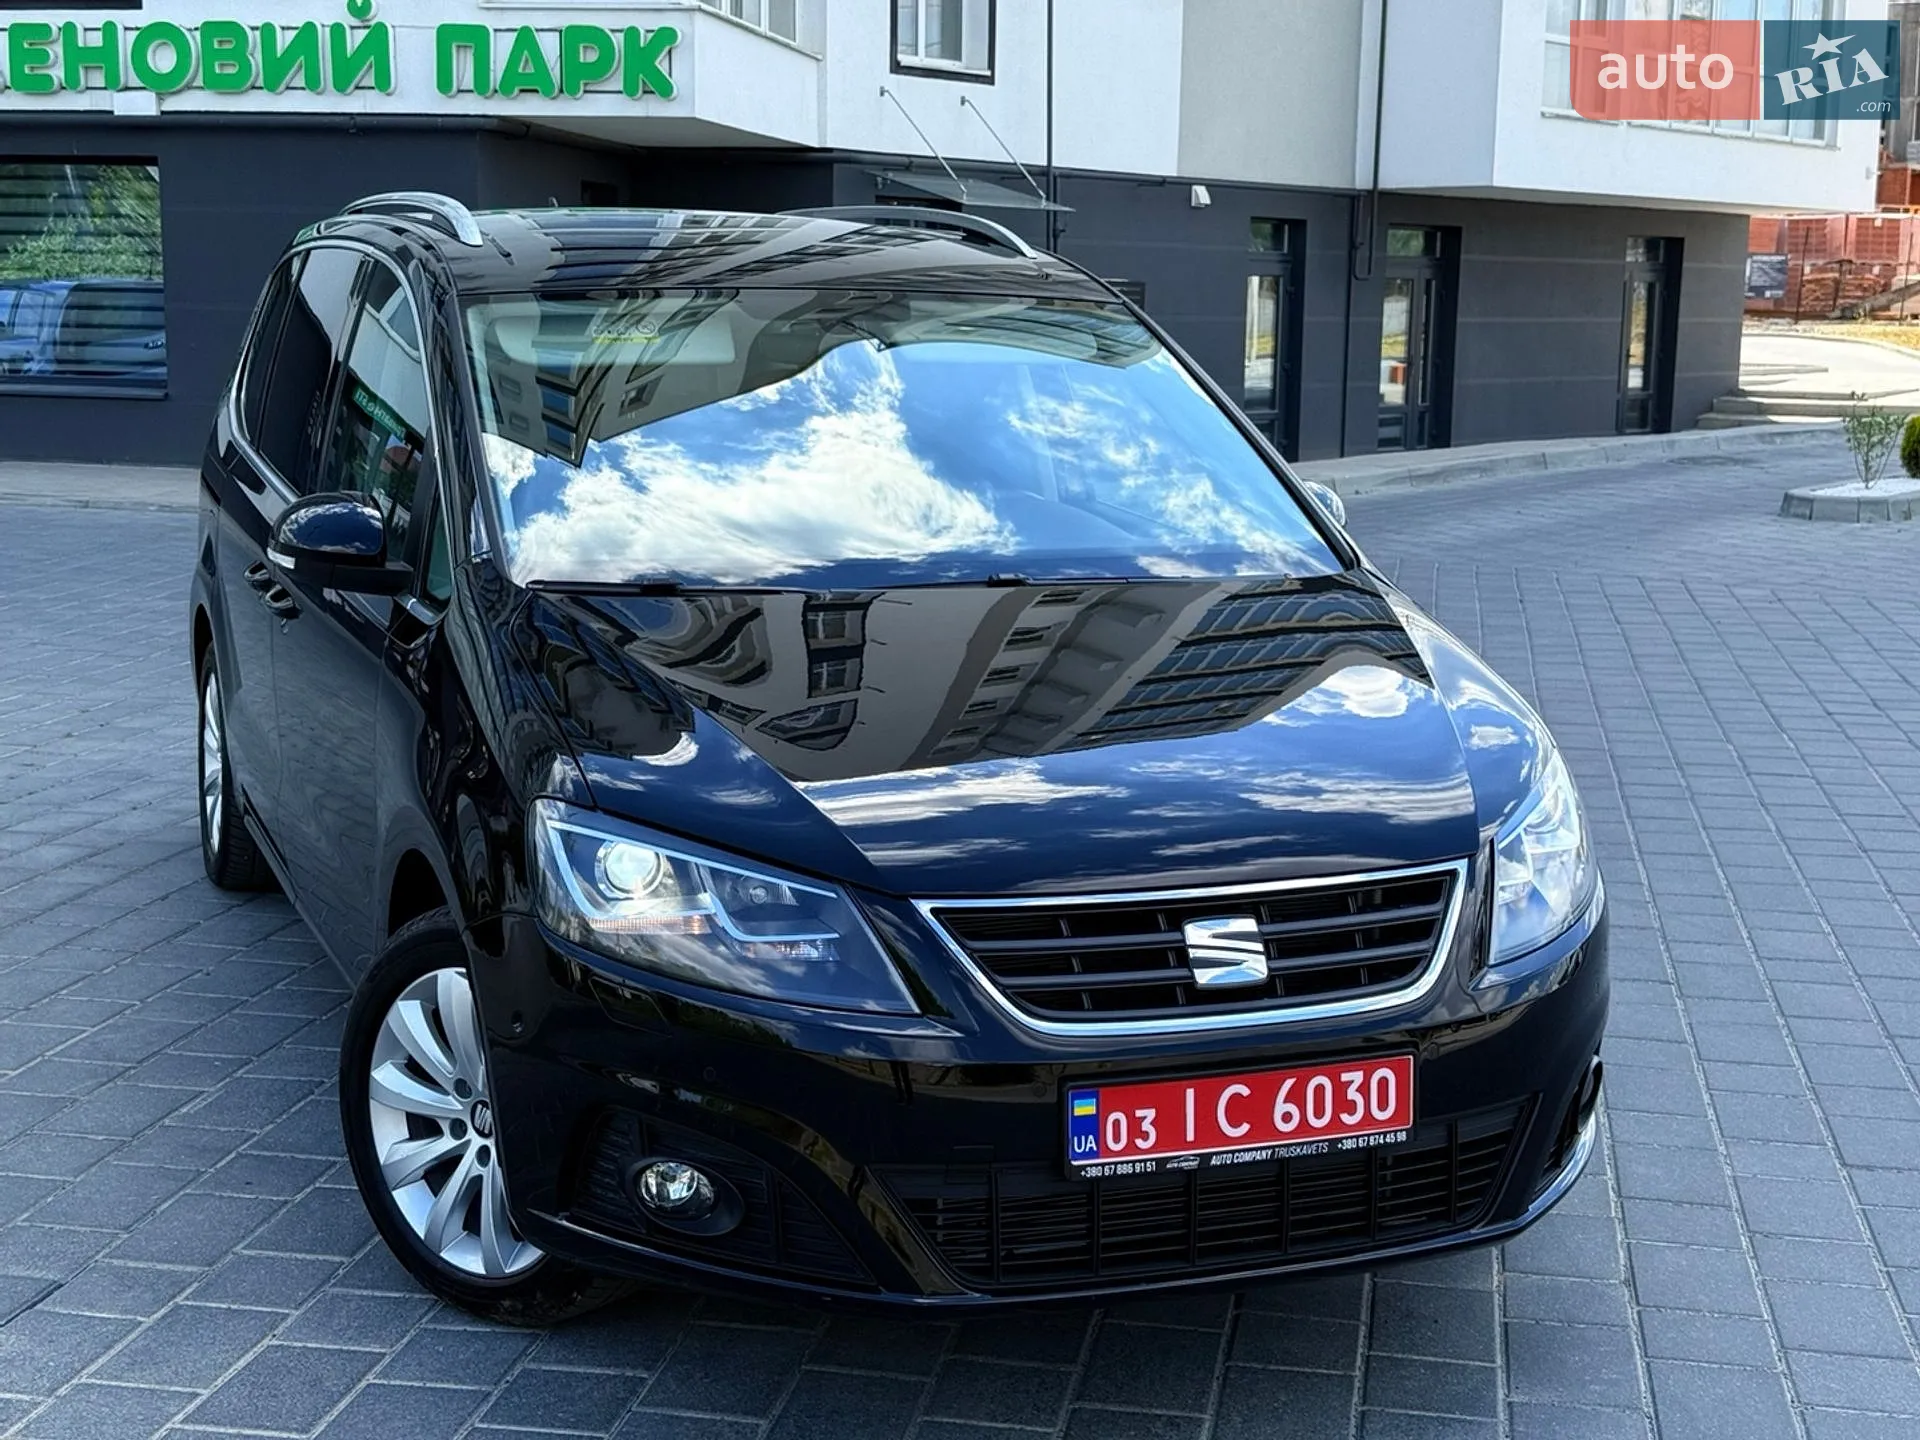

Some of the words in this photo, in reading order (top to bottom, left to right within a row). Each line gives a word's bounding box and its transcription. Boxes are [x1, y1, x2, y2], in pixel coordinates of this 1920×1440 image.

[0, 0, 396, 95] ЕНОВИЙ
[436, 23, 682, 100] ПАРК
[1105, 1108, 1157, 1151] 03
[1273, 1067, 1398, 1133] 6030
[1073, 1135, 1098, 1153] UA
[1210, 1153, 1232, 1166] AUTO
[1234, 1149, 1273, 1163] COMPANY
[1274, 1142, 1329, 1159] TRUSKAVETS
[1337, 1137, 1357, 1150] +380
[1080, 1165, 1103, 1178] +380
[1104, 1164, 1115, 1176] 67
[1146, 1161, 1156, 1172] 51
